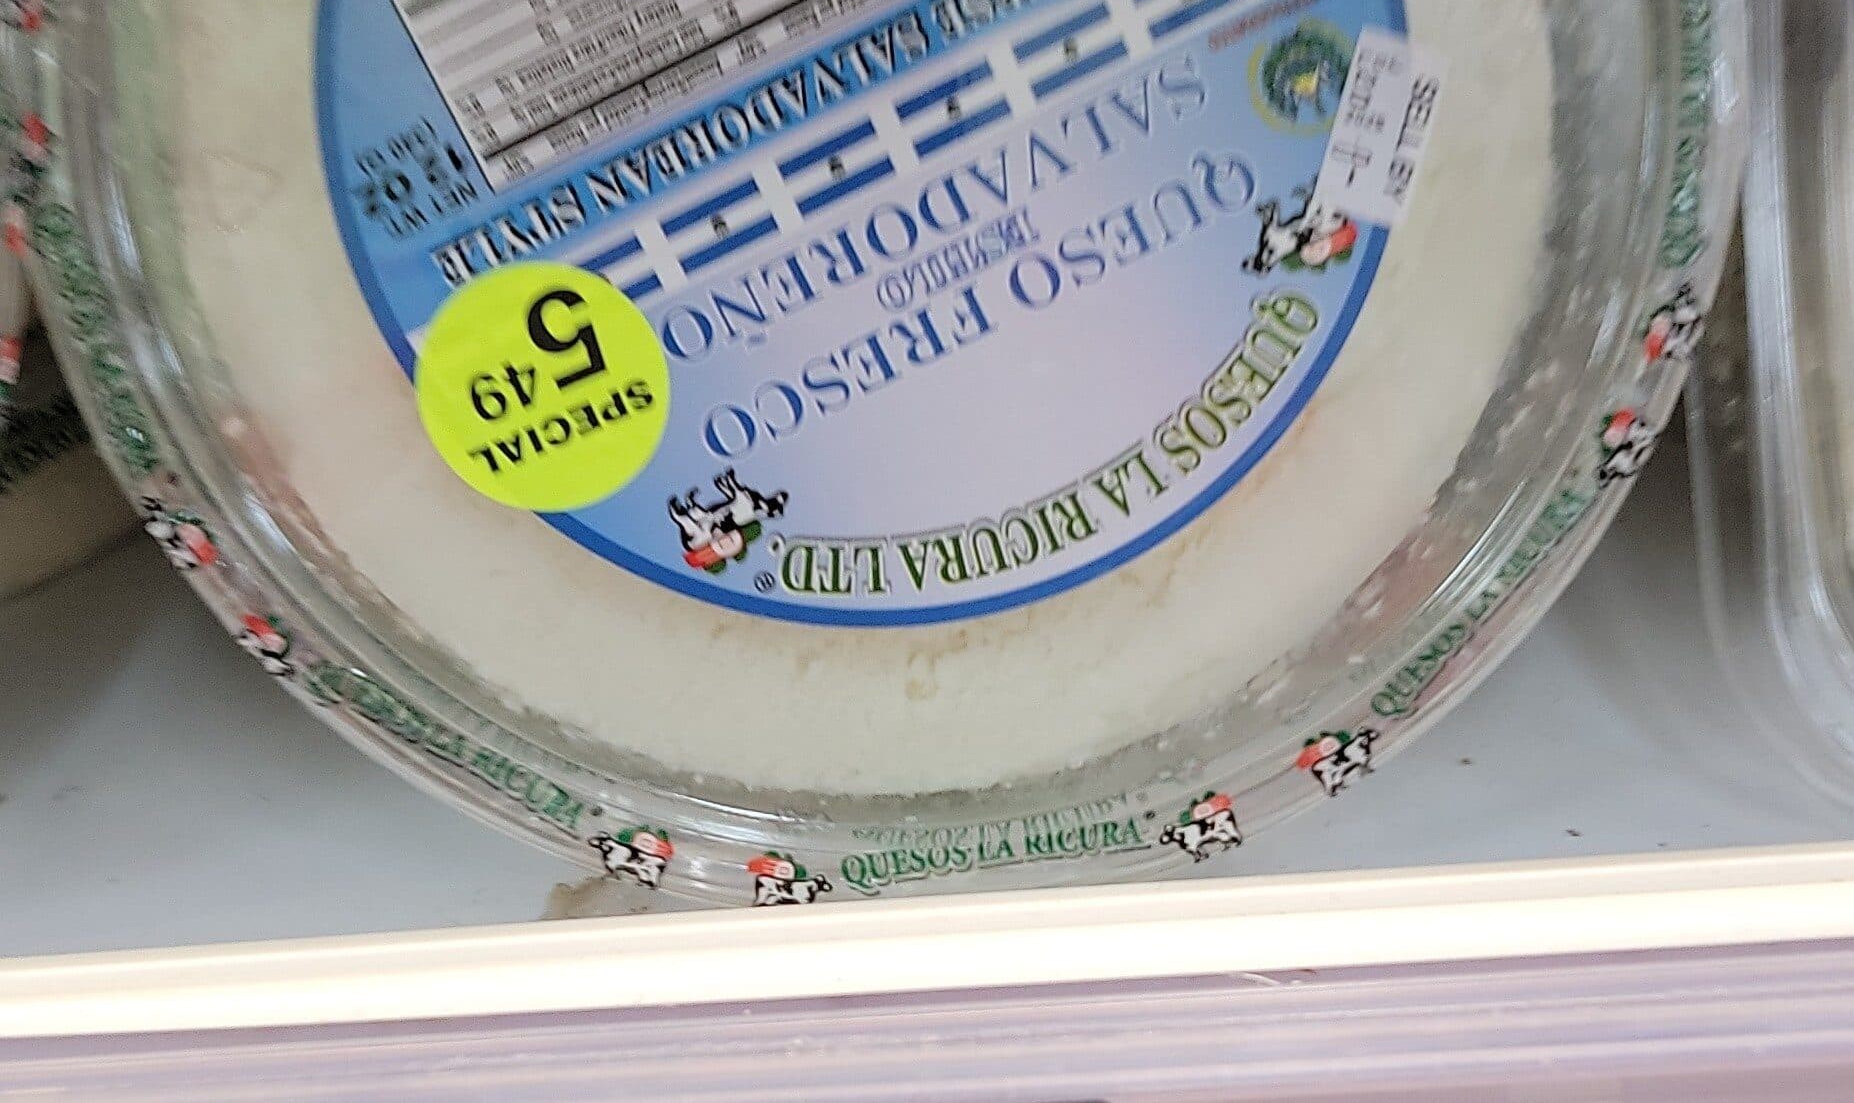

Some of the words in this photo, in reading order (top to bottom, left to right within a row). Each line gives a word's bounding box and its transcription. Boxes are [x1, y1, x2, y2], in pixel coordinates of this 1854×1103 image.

[587, 9, 929, 217] SALVADOREAN
[431, 183, 587, 288] STYLE
[661, 52, 1206, 362] SALVADOREÑO
[1008, 148, 1257, 310] QUESO
[467, 380, 653, 474] SPECIAL
[703, 283, 999, 460] FRESCO
[1152, 286, 1320, 475] QUESOS
[898, 489, 1099, 592] RICURA
[1083, 440, 1170, 517] LA
[840, 846, 970, 890] QUESOS
[977, 839, 1015, 863] LA
[1023, 817, 1143, 857] RICURA
